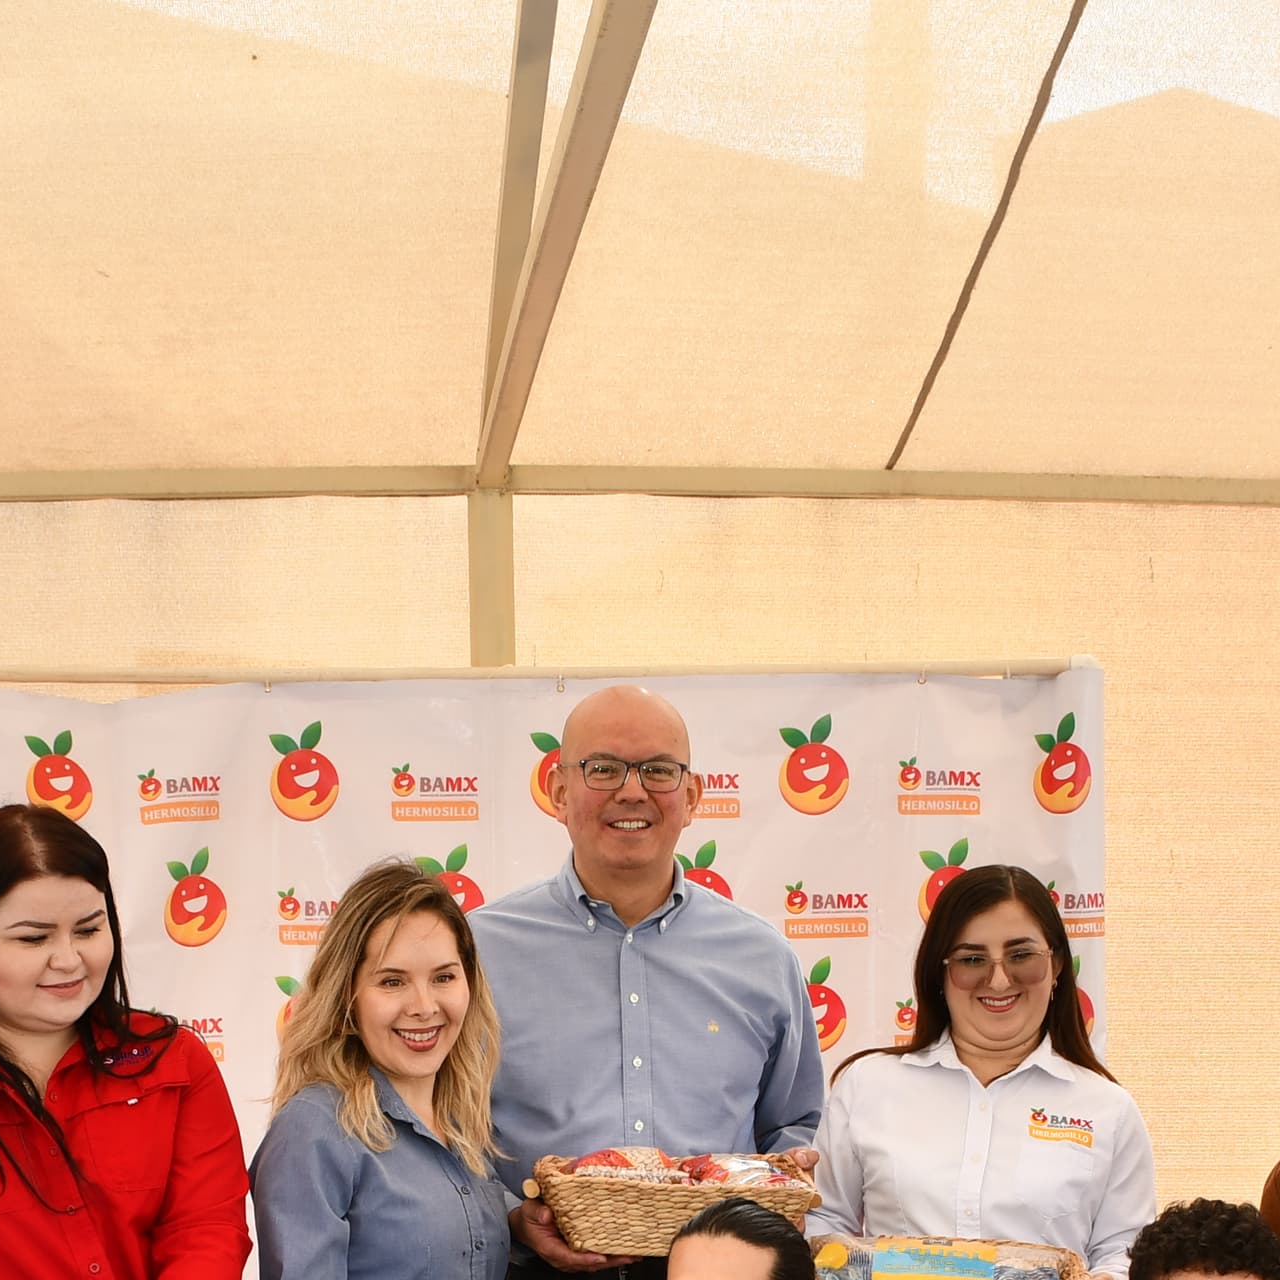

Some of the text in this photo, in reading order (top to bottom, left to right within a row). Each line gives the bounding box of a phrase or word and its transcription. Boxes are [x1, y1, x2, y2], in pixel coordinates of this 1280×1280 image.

[166, 776, 220, 794] BAMX
[419, 776, 478, 793] BAMX
[701, 773, 739, 789] MX
[925, 770, 981, 787] BAMX
[395, 806, 477, 817] HERMOSILLO
[901, 799, 978, 811] HERMOSILLO
[144, 806, 218, 821] HERMOSILLO
[812, 893, 868, 910] BAMX
[788, 922, 867, 935] HERMOSILLO
[1051, 1115, 1093, 1129] BAMX
